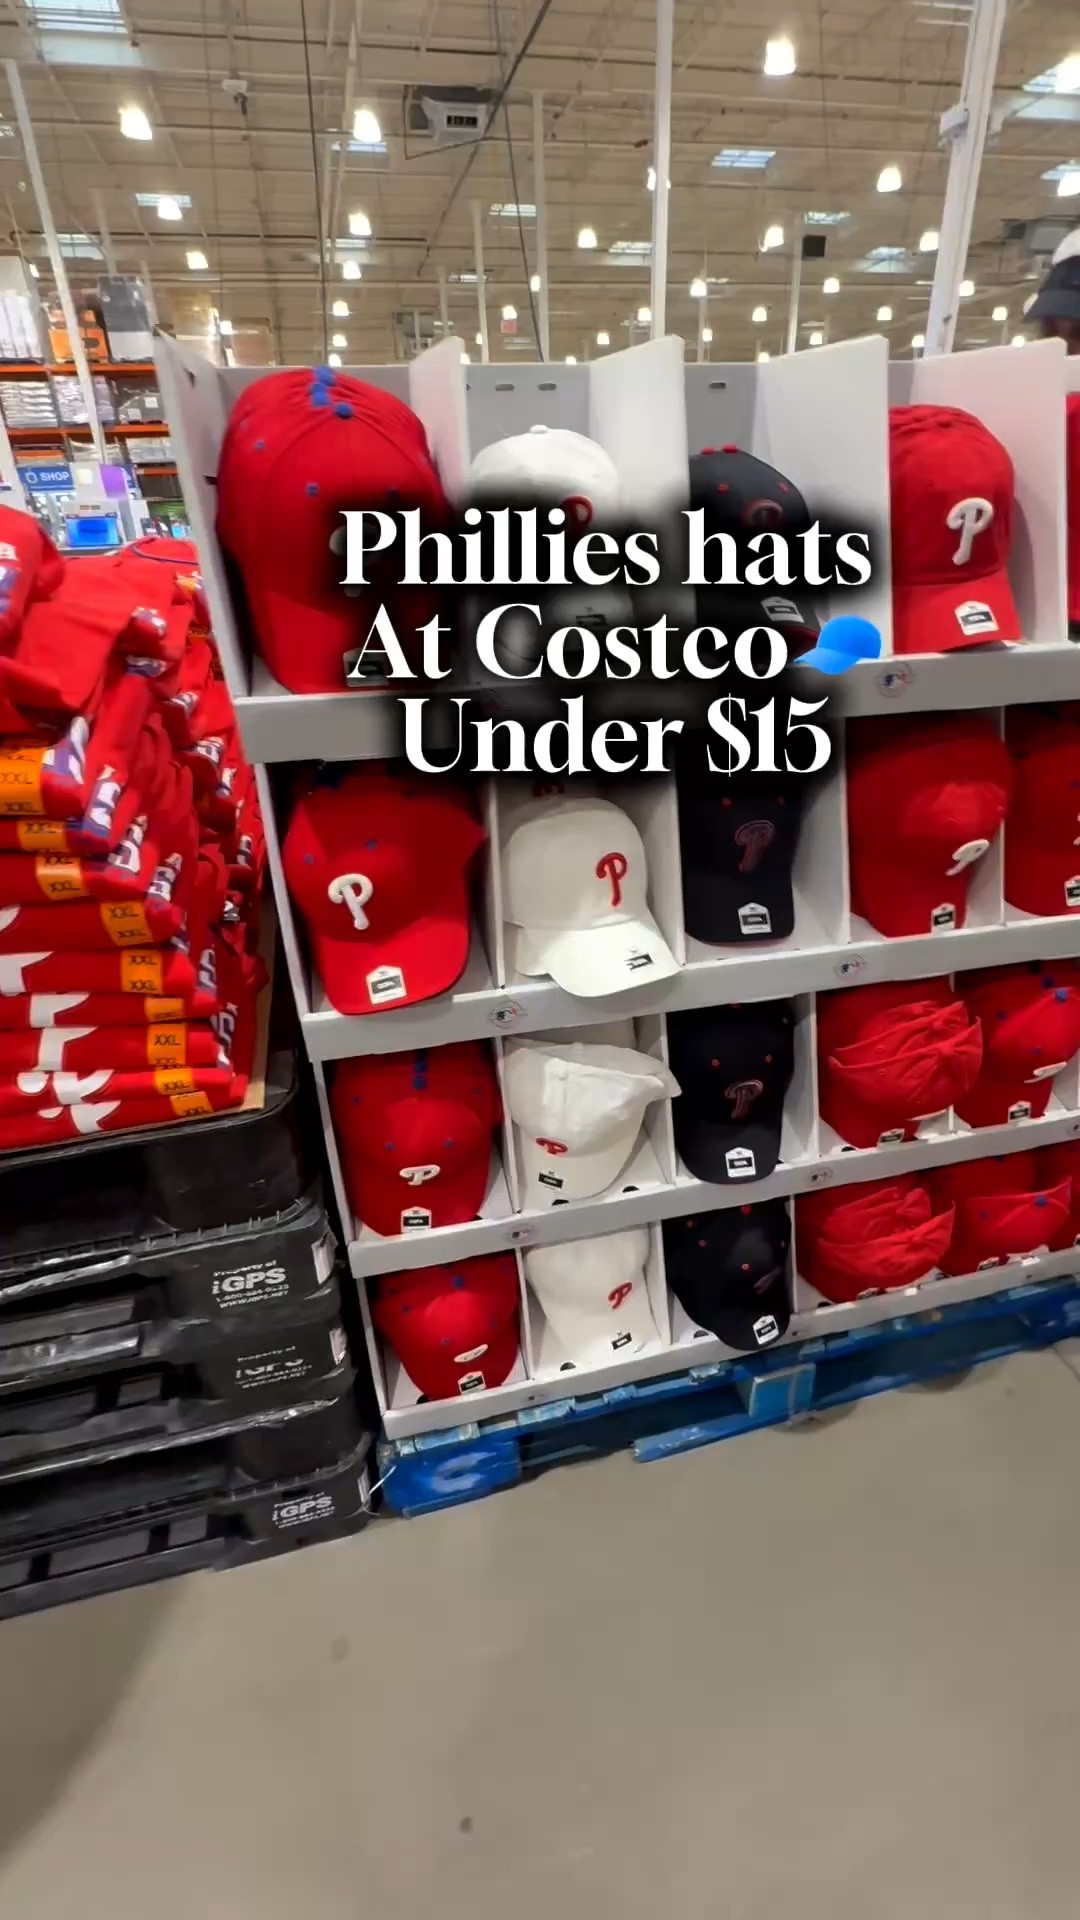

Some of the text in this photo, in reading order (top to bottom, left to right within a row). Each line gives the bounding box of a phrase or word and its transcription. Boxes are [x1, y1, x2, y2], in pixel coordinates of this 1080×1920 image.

[41, 471, 70, 482] SHOP
[946, 496, 994, 566] P
[733, 819, 776, 872] P
[596, 851, 627, 907] P
[108, 901, 139, 918] XXL
[328, 872, 373, 931] P
[117, 928, 147, 939] XXL
[129, 955, 157, 966] XXL
[129, 980, 158, 992] XXL
[154, 1033, 181, 1047] XXL
[163, 1080, 191, 1093] XXL
[725, 1079, 764, 1119] P
[212, 1267, 286, 1295] iGPS
[272, 1496, 332, 1521] iGPS
